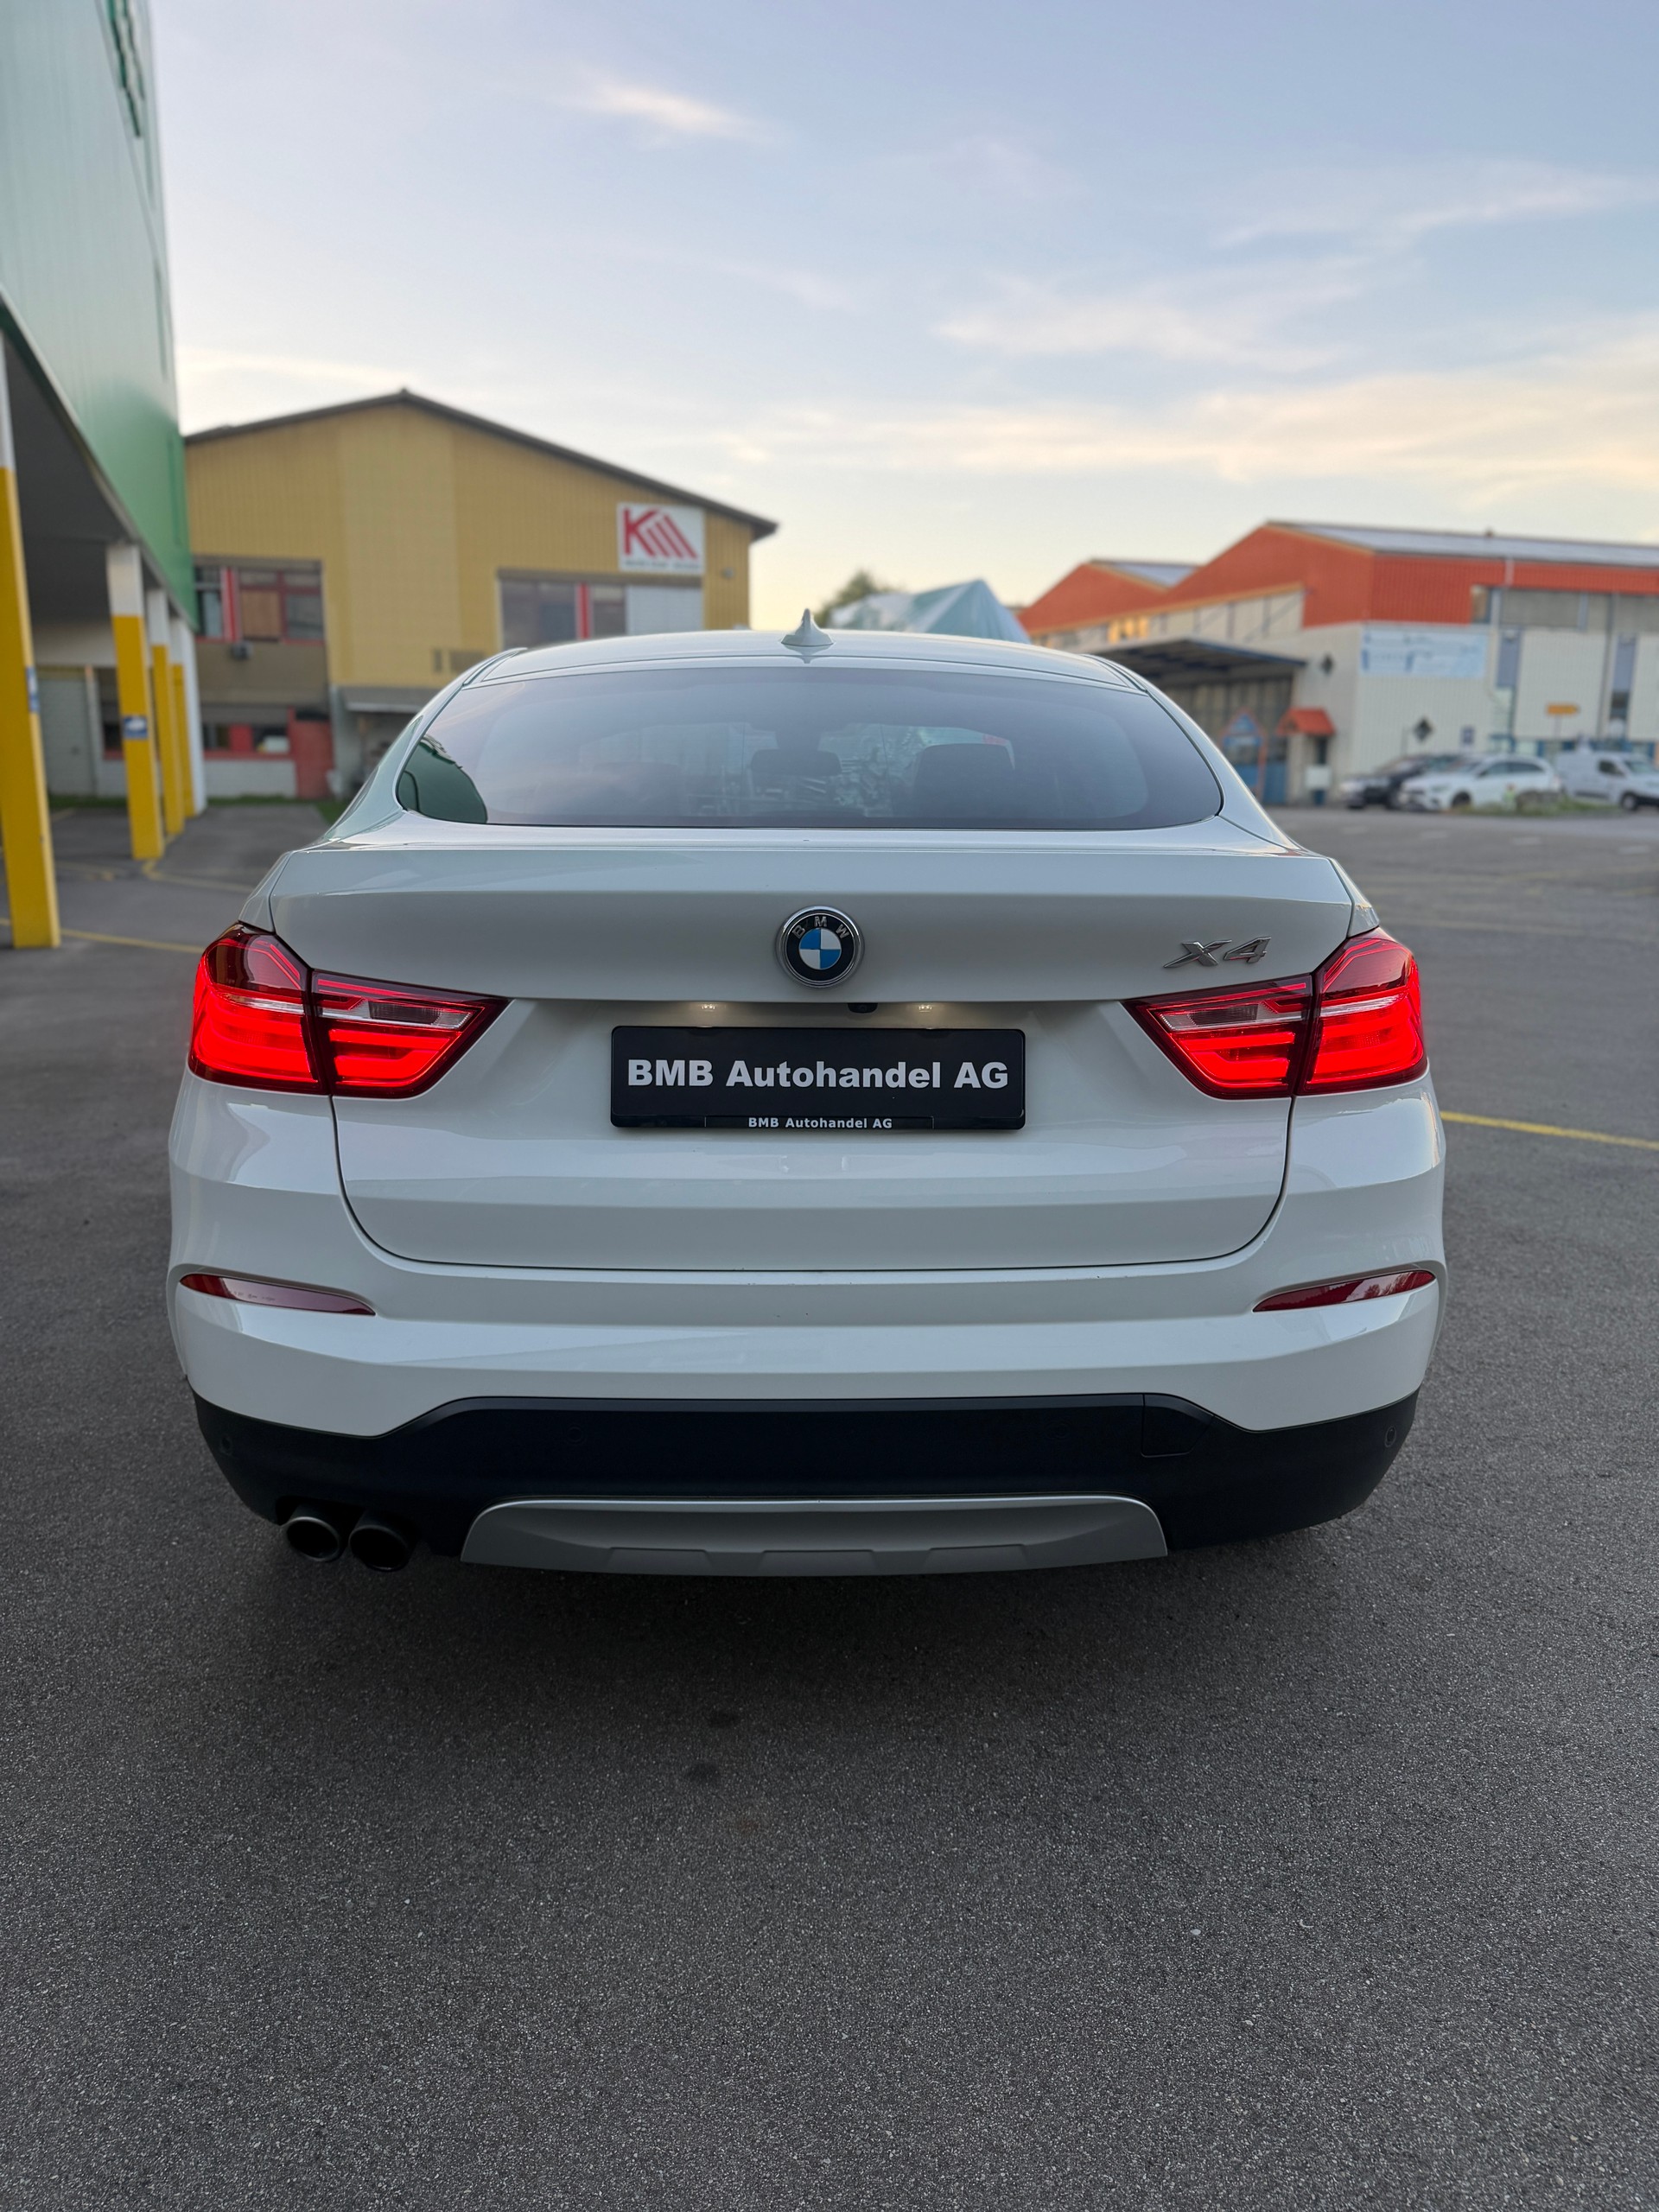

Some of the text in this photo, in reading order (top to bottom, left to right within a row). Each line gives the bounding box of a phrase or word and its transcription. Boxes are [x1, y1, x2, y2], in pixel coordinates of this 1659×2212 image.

[791, 916, 850, 939] BMW
[1163, 937, 1272, 968] X4
[628, 1059, 1007, 1088] BMB Autohandel AG
[749, 1118, 892, 1128] BMB Autohandel AG
